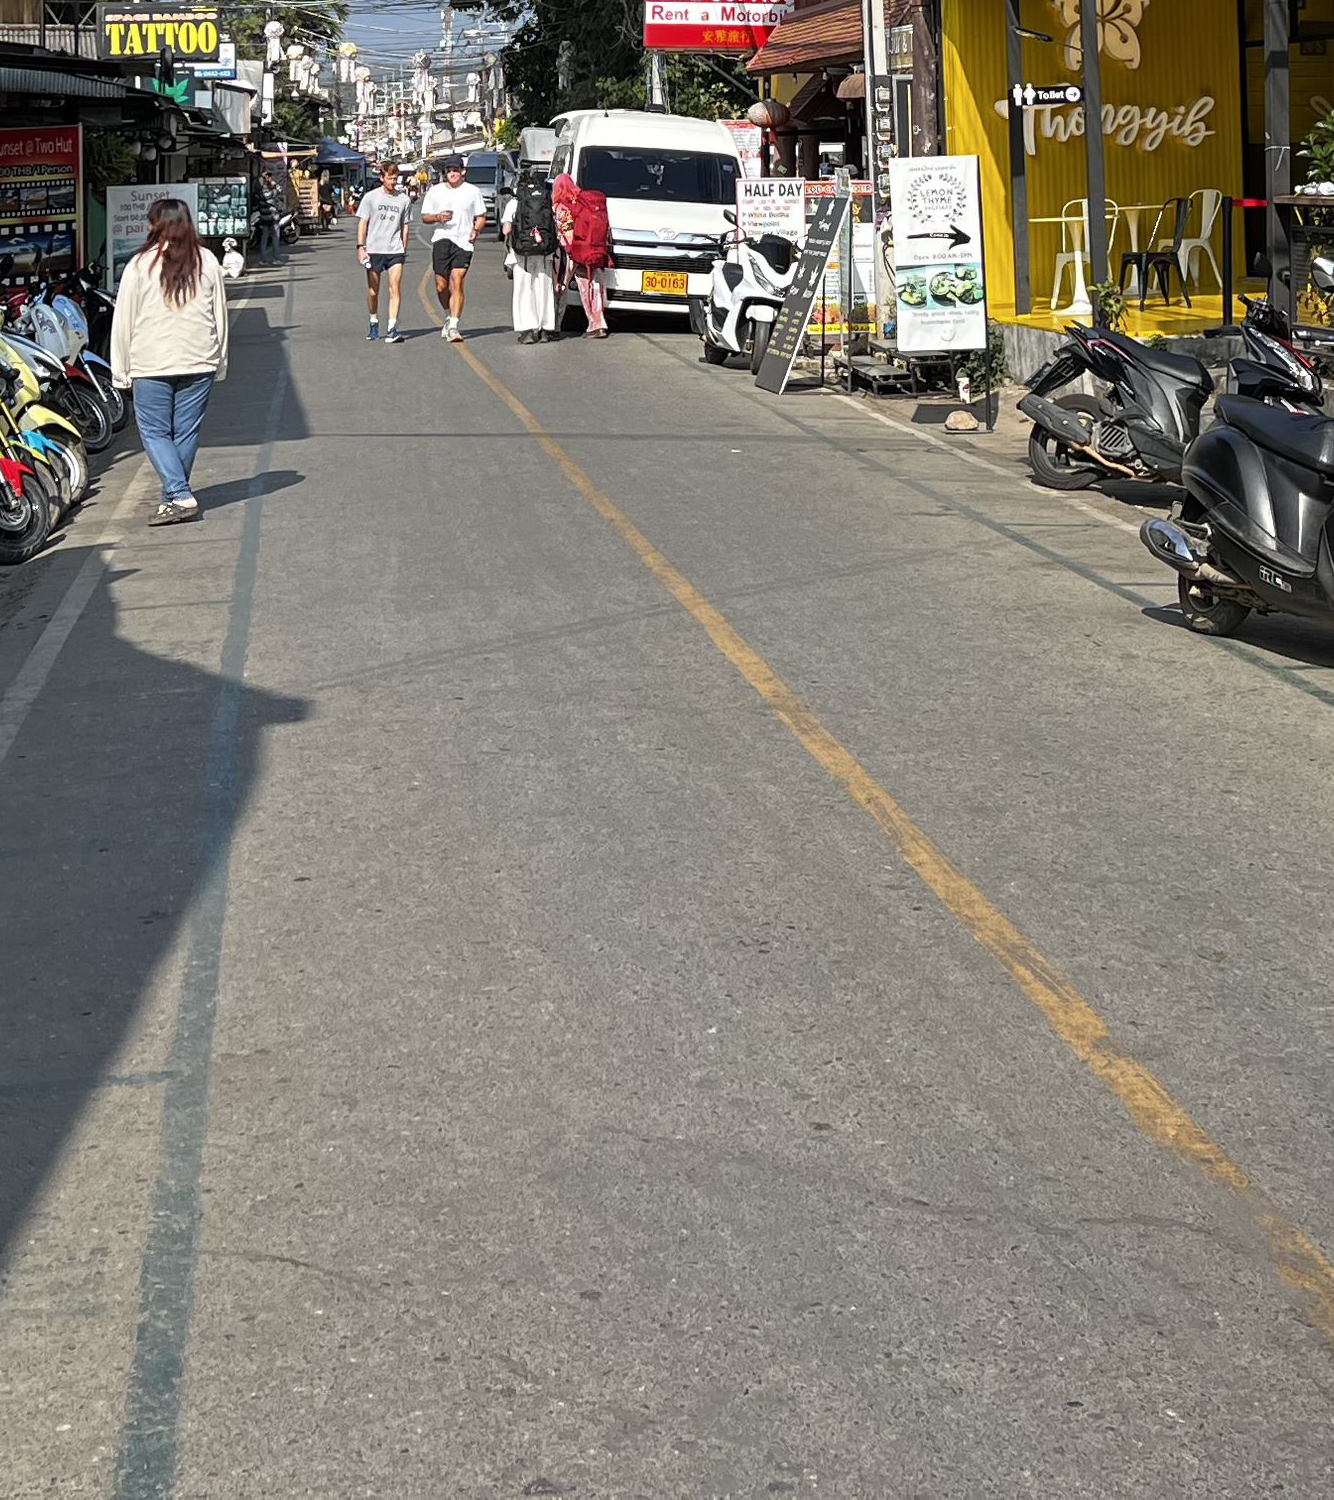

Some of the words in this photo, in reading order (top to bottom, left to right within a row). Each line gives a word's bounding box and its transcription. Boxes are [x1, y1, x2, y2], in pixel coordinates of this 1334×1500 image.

[652, 6, 689, 21] Rent
[701, 11, 709, 21] a
[105, 21, 217, 55] TATTOO
[1037, 90, 1064, 100] Toilet
[35, 138, 54, 153] Two
[56, 137, 73, 152] Hut
[744, 183, 774, 197] HALF
[779, 183, 803, 197] DAY
[920, 189, 953, 197] LEMON
[126, 223, 143, 235] pai
